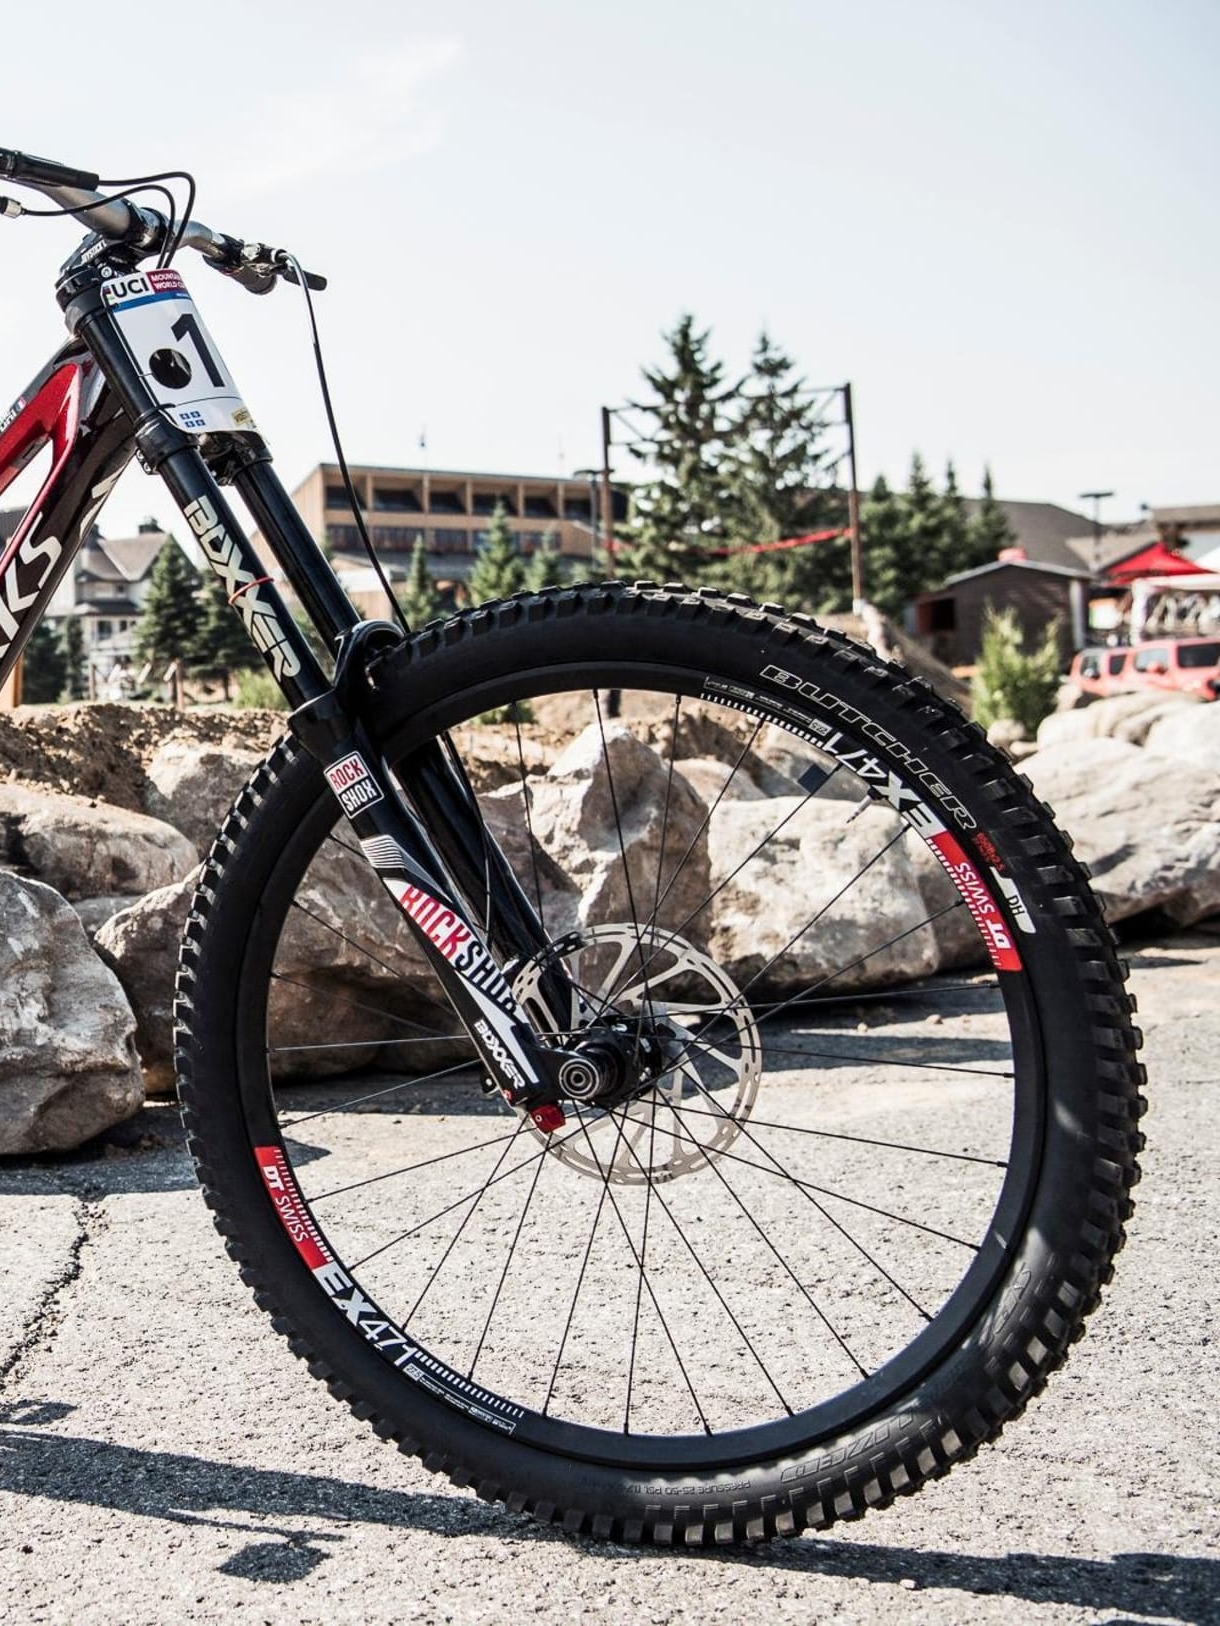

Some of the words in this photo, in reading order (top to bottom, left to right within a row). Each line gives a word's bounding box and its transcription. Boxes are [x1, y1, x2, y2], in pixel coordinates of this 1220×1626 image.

[111, 277, 150, 298] UCI
[171, 313, 225, 387] 1
[183, 495, 301, 682] BOXXER
[759, 664, 978, 830] BUTCHER
[330, 758, 364, 790] ROCK
[340, 779, 378, 812] SHOX
[954, 862, 995, 914] SWISS
[1008, 895, 1026, 915] DH
[985, 919, 1012, 949] DT
[473, 1018, 526, 1089] BOXXER
[262, 1164, 285, 1191] DT
[275, 1194, 310, 1243] SWISS
